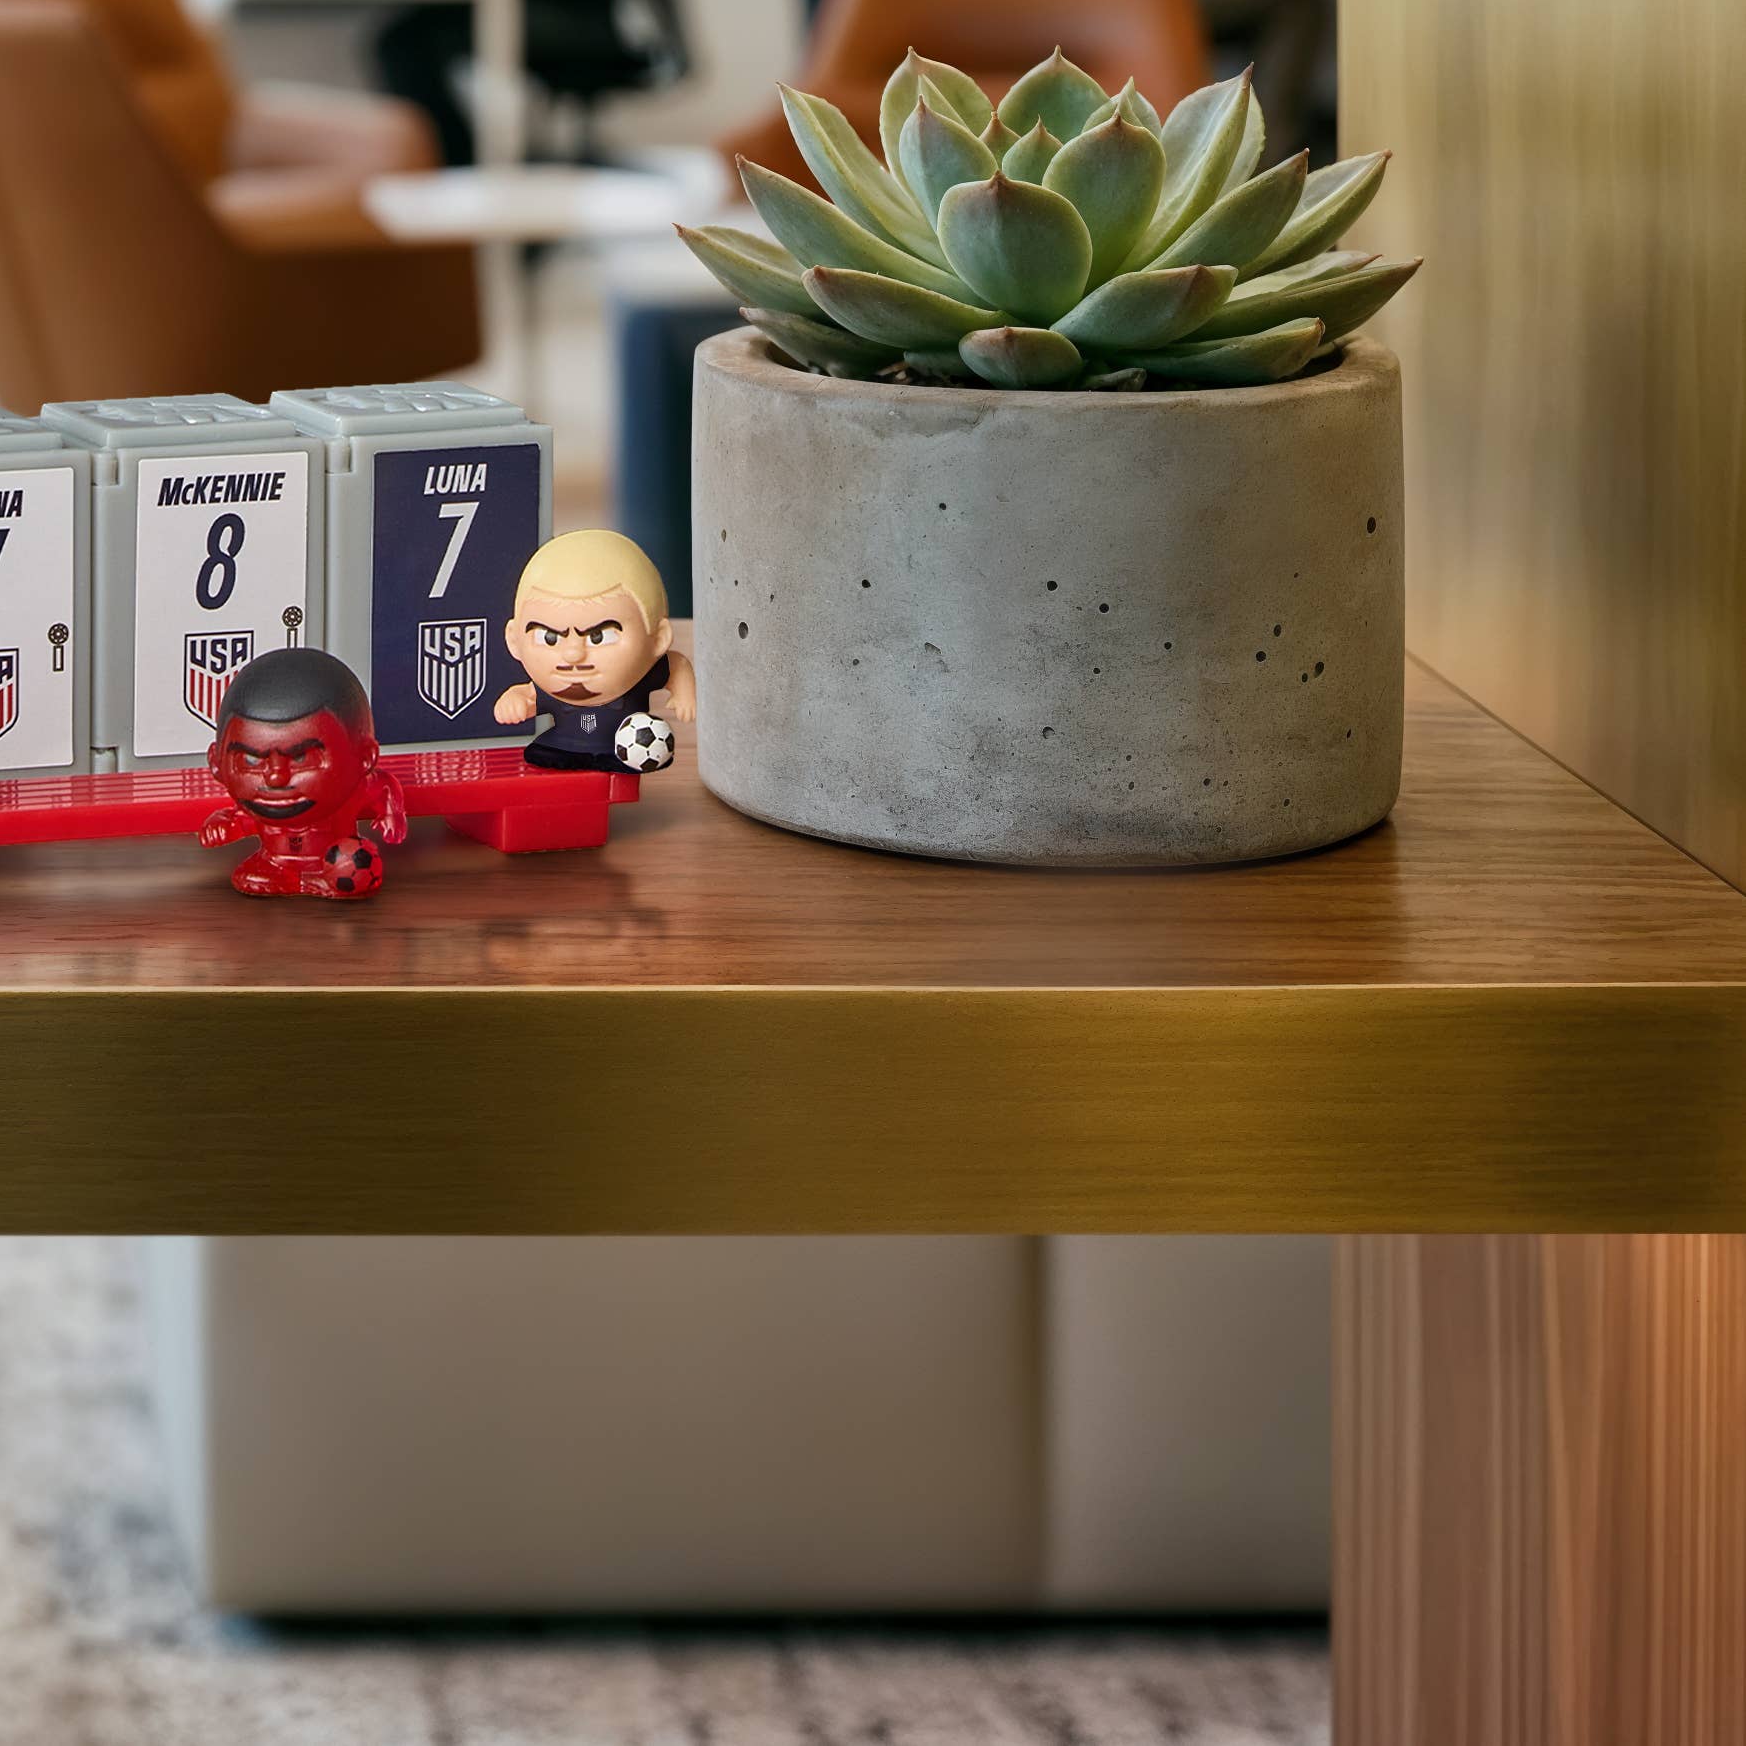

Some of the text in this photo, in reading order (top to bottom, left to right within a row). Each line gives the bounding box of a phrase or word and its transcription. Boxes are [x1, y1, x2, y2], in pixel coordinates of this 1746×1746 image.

[157, 472, 286, 506] McKENNIE
[424, 463, 488, 495] LUNA
[196, 513, 245, 610] 8
[428, 501, 480, 599] 7
[190, 637, 248, 675] USA
[424, 625, 482, 663] USA
